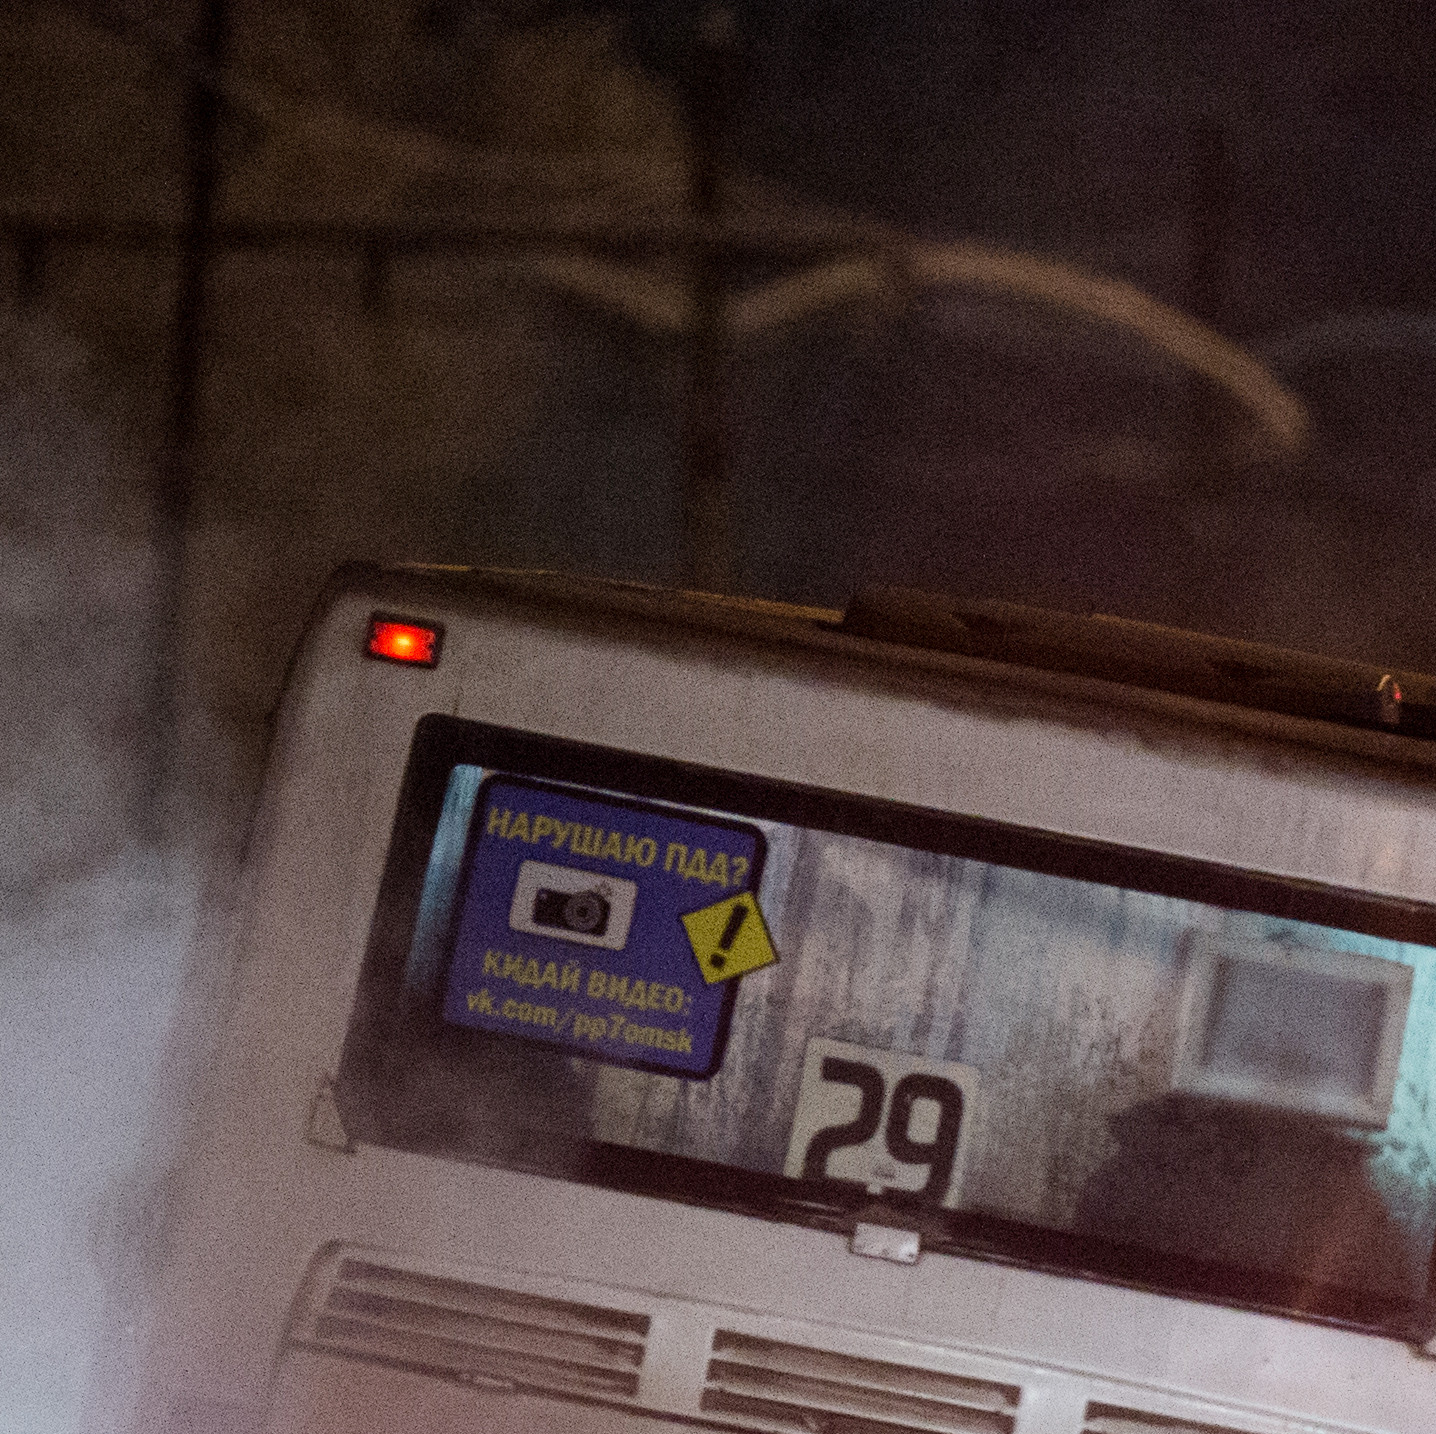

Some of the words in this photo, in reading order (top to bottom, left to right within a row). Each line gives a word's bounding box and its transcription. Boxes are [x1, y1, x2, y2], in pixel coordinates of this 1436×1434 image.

[487, 807, 657, 867] НАРУШАЮ
[663, 842, 749, 887] ПДД?
[482, 950, 580, 992] КИДАЙ
[586, 970, 692, 1015] ВИДЕО:
[803, 1056, 963, 1206] 29
